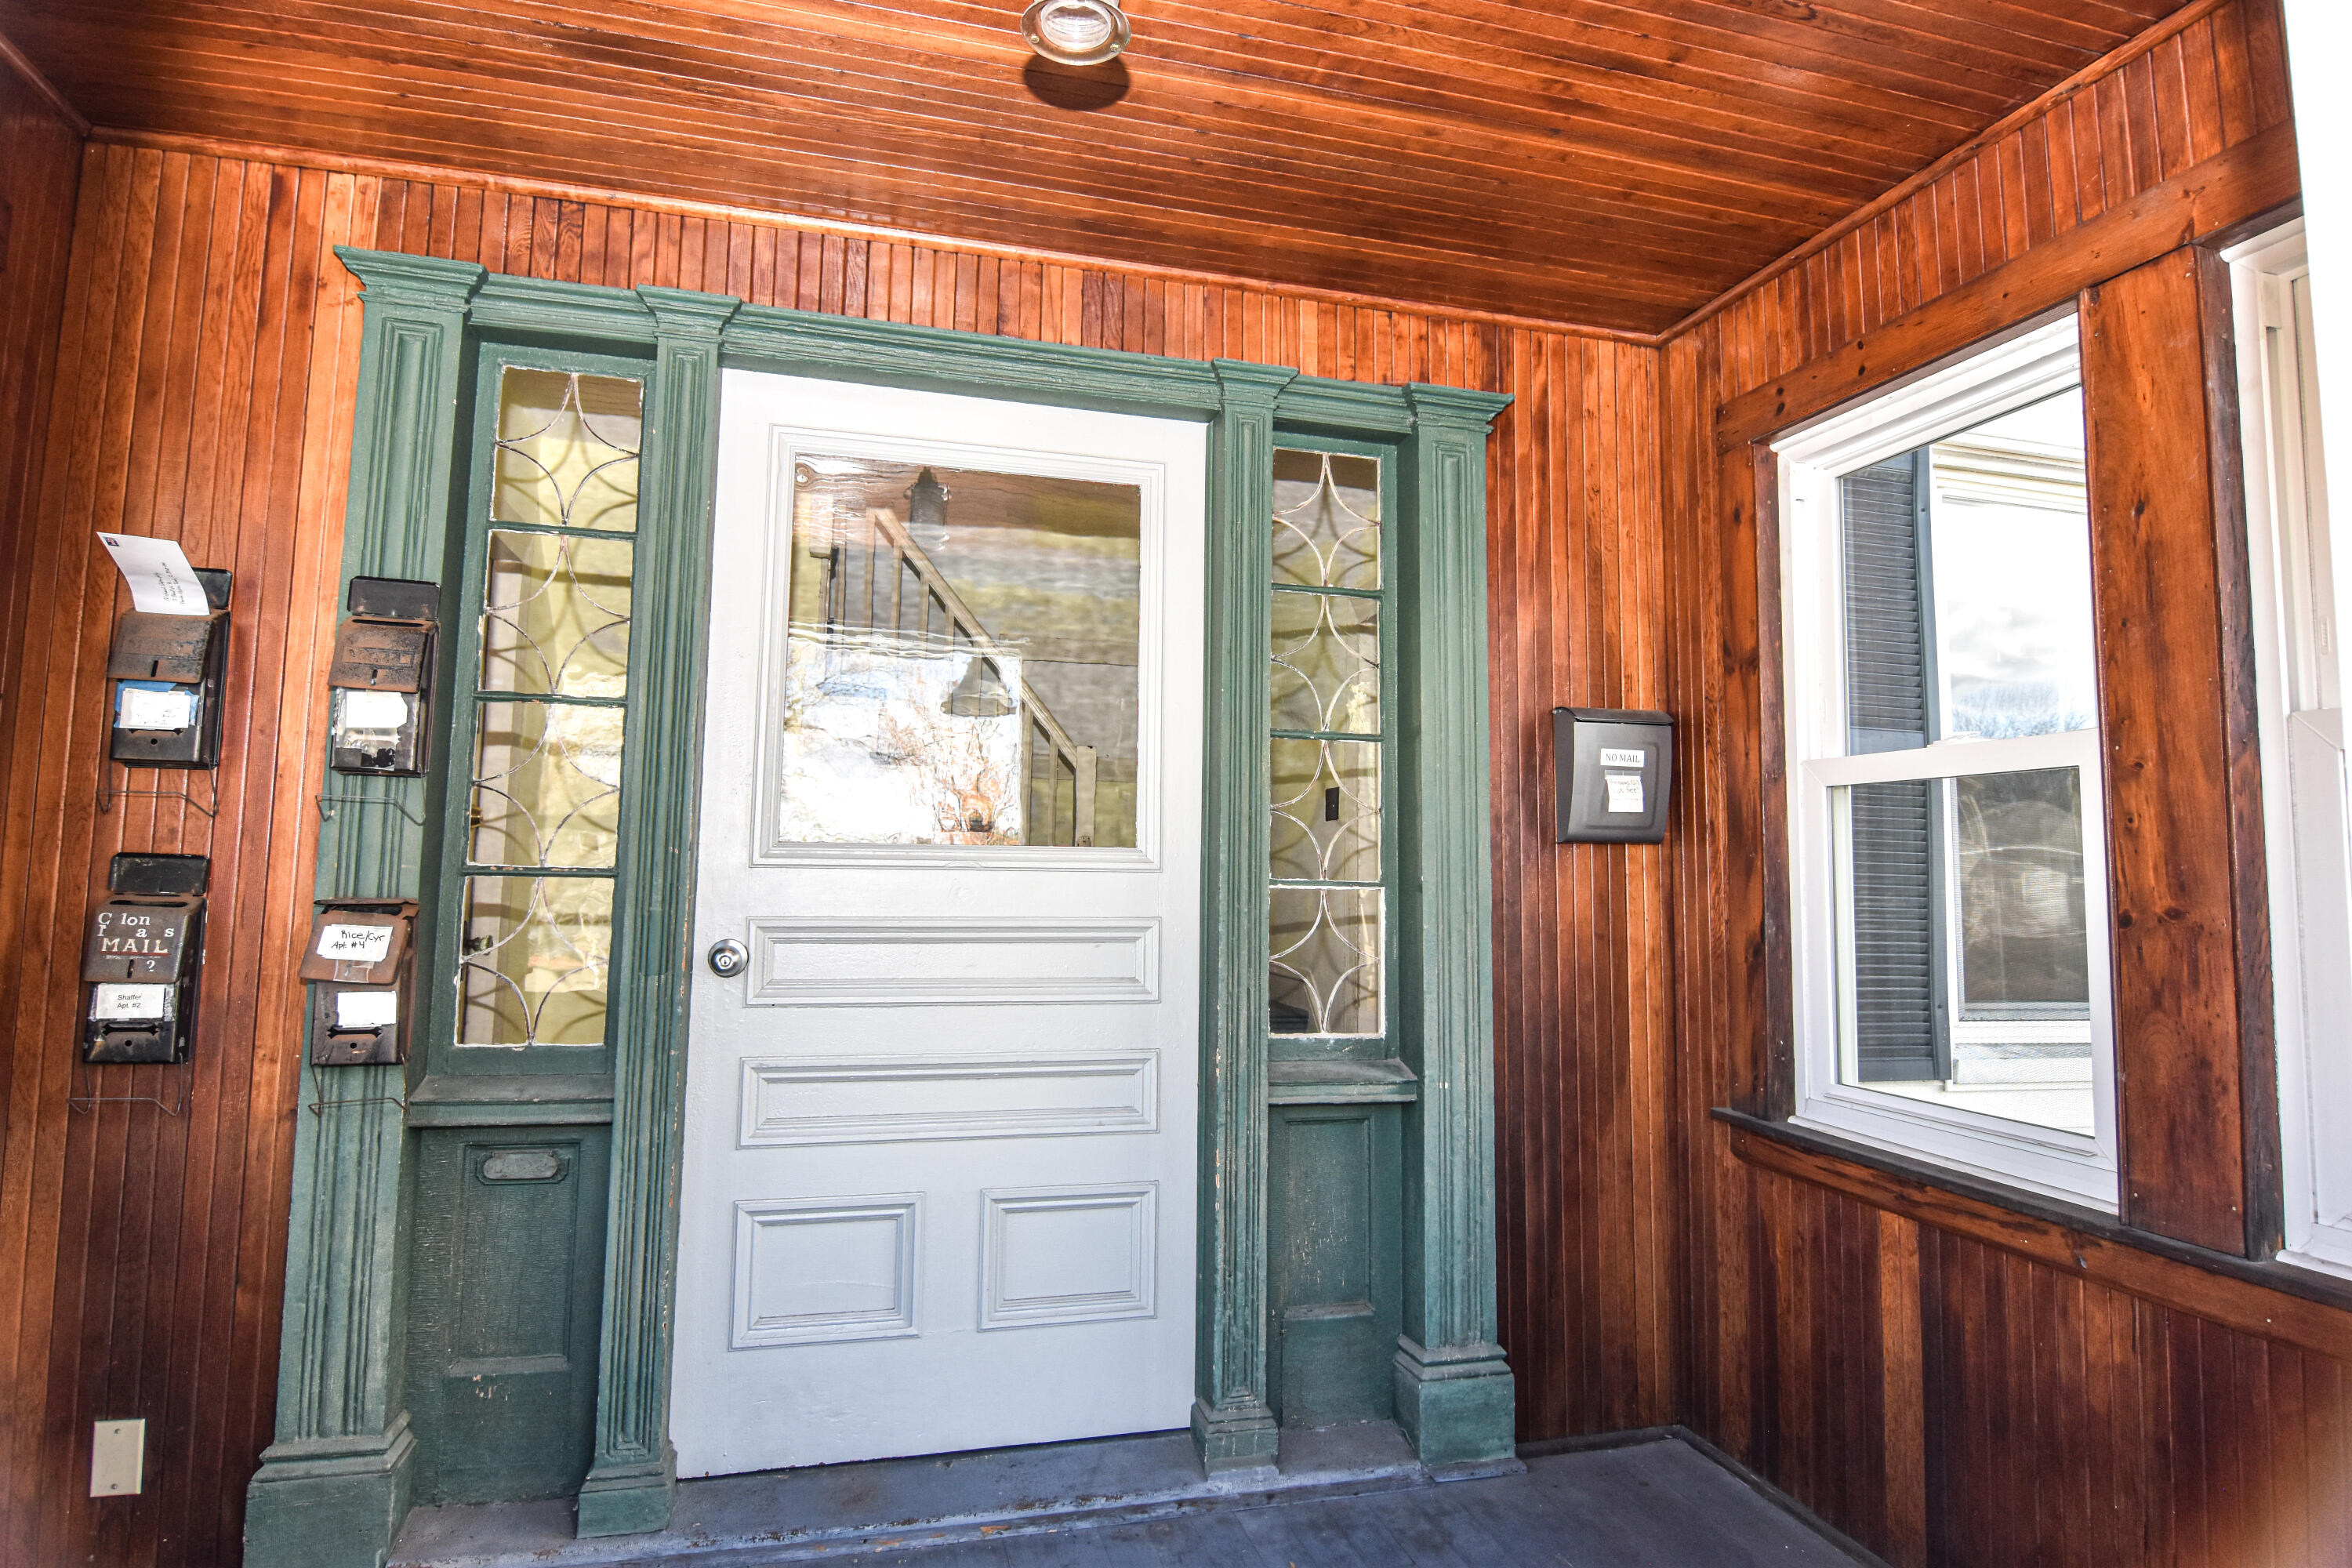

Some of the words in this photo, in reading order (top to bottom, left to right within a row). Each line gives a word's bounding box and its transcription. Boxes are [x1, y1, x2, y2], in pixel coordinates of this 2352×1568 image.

[1606, 753, 1617, 762] NO
[1619, 754, 1640, 763] MAIL
[101, 938, 169, 953] MAIL
